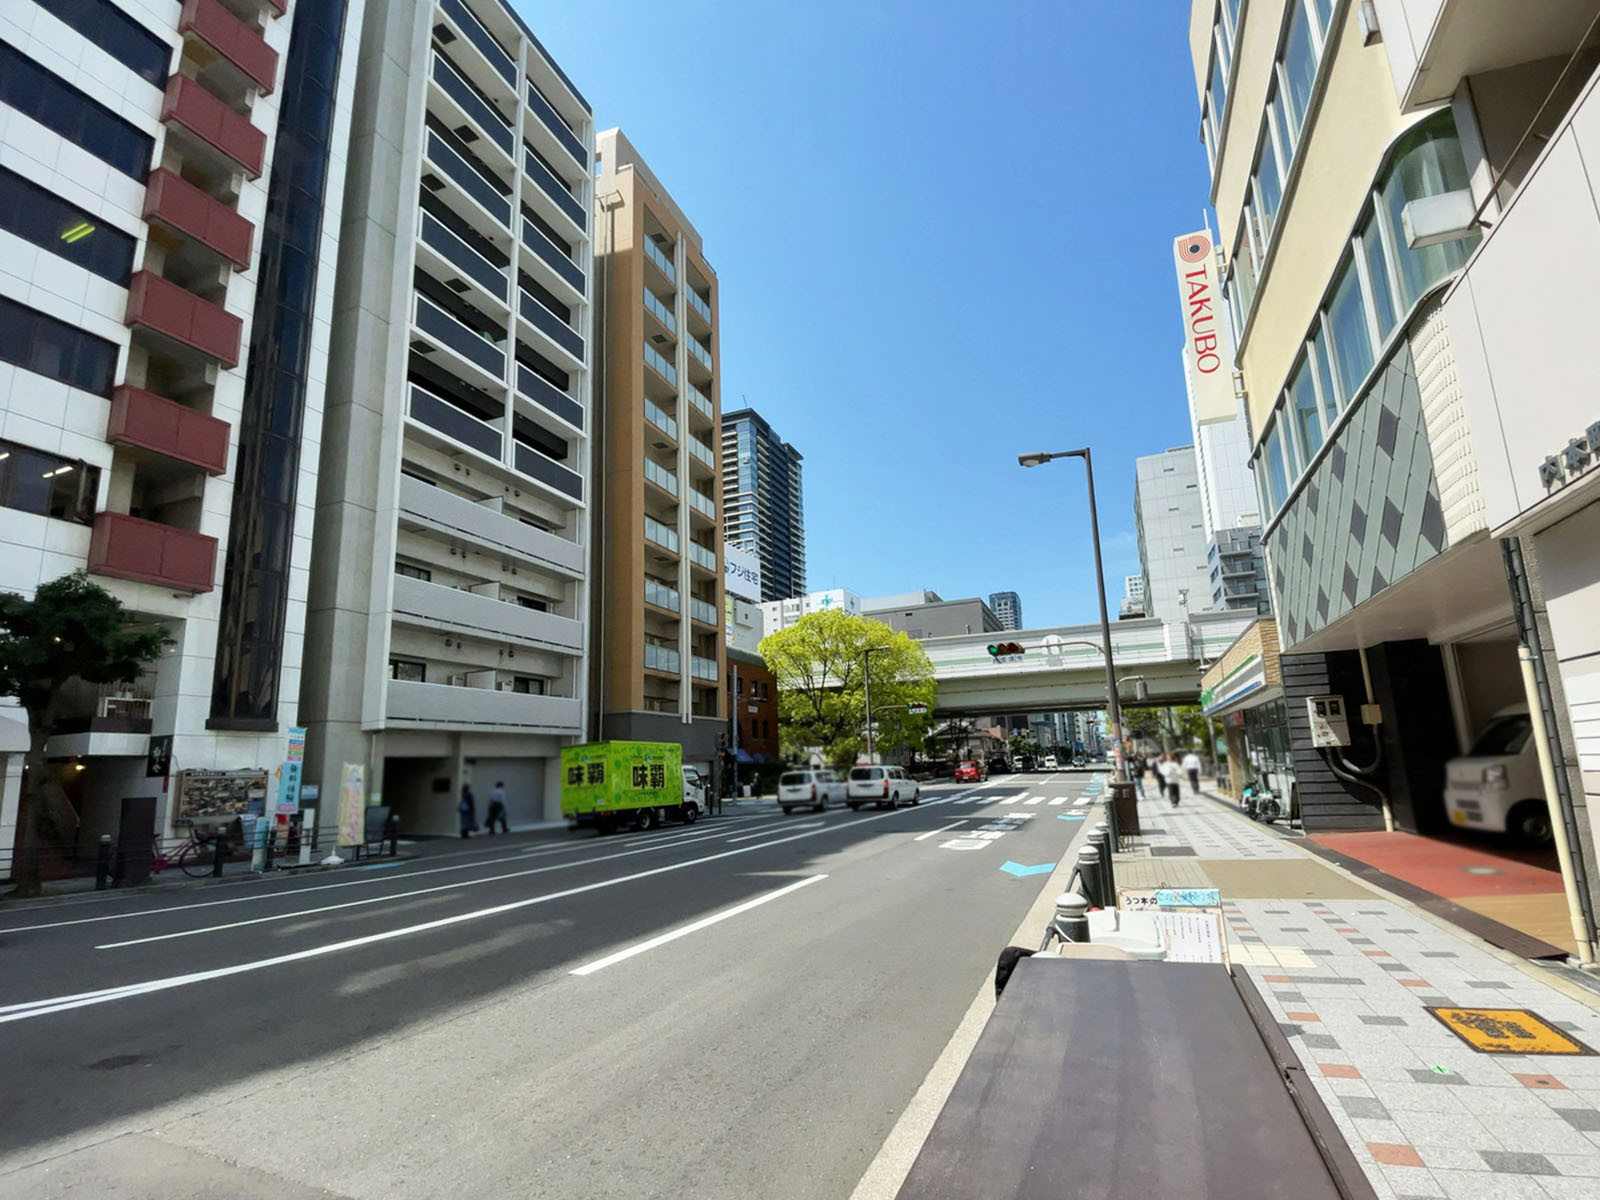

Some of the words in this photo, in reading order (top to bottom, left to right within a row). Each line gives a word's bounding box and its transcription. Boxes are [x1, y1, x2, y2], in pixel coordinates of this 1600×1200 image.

[1185, 264, 1221, 374] TAKUBO
[729, 561, 759, 585] フジ住宅
